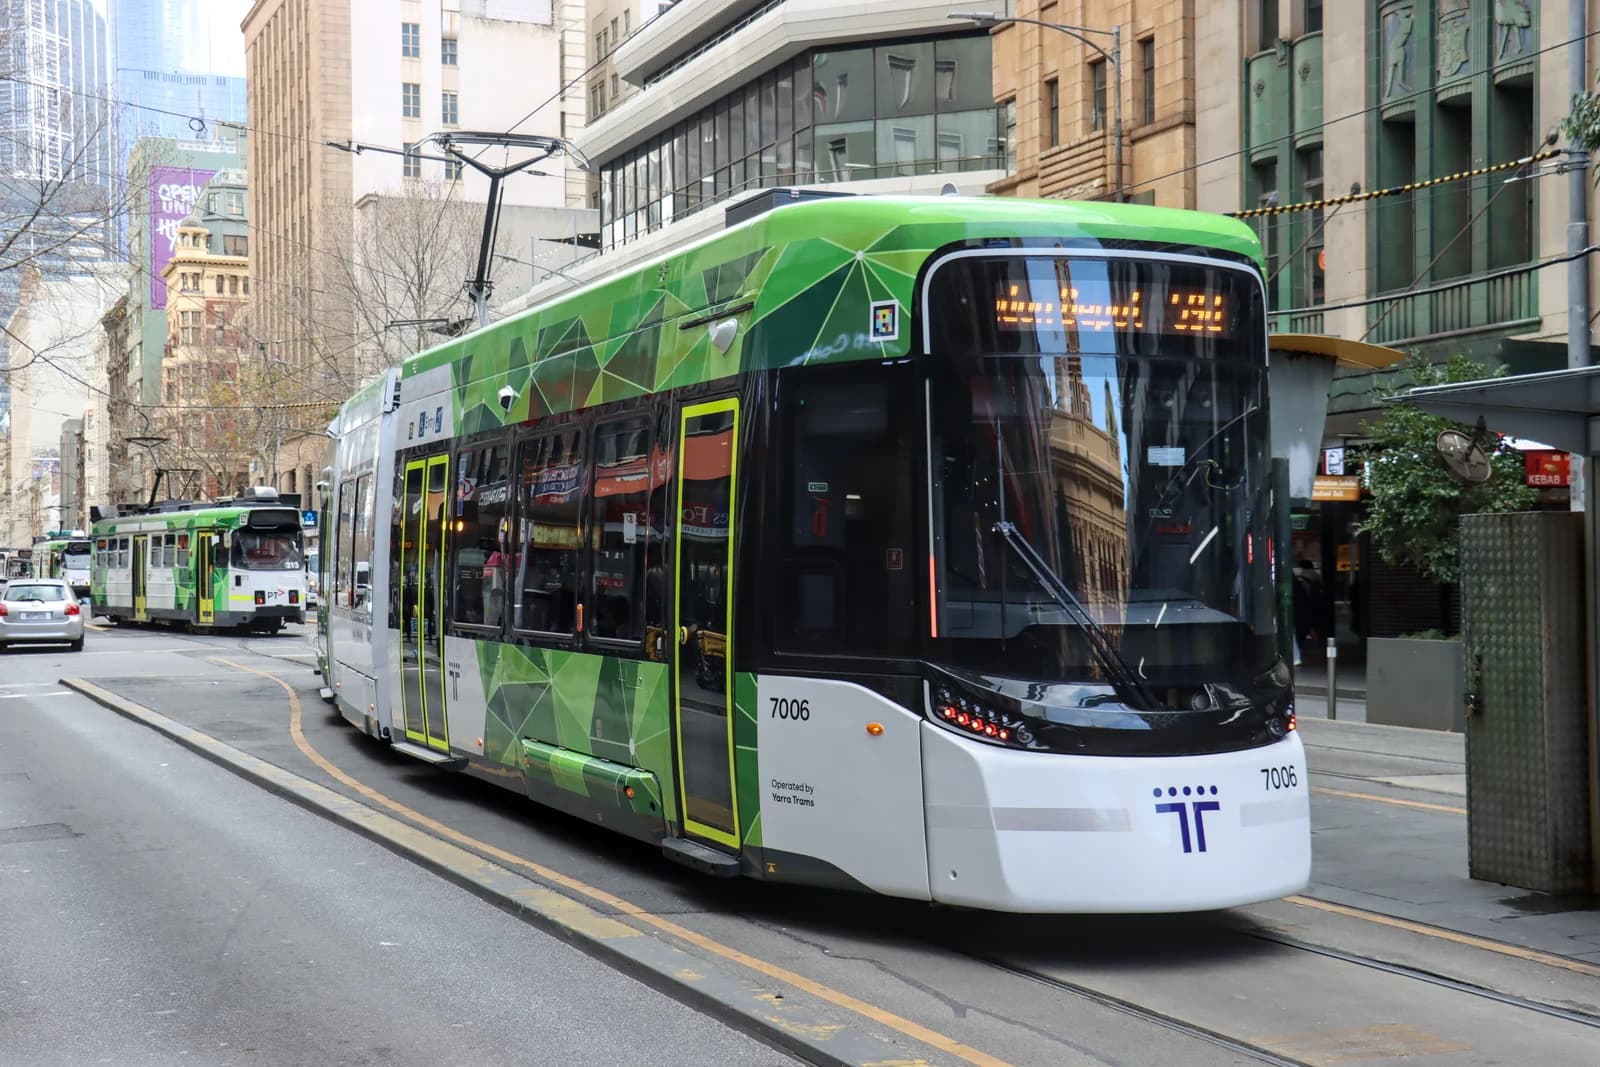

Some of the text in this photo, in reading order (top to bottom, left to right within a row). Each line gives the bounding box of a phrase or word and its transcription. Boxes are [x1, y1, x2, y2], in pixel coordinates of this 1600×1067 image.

[1529, 475, 1560, 485] KEBAB
[286, 561, 299, 569] 213
[770, 697, 810, 721] 7006
[1261, 765, 1297, 791] 7006
[771, 779, 814, 795] Operated by
[772, 793, 814, 807] Yarra Trams
